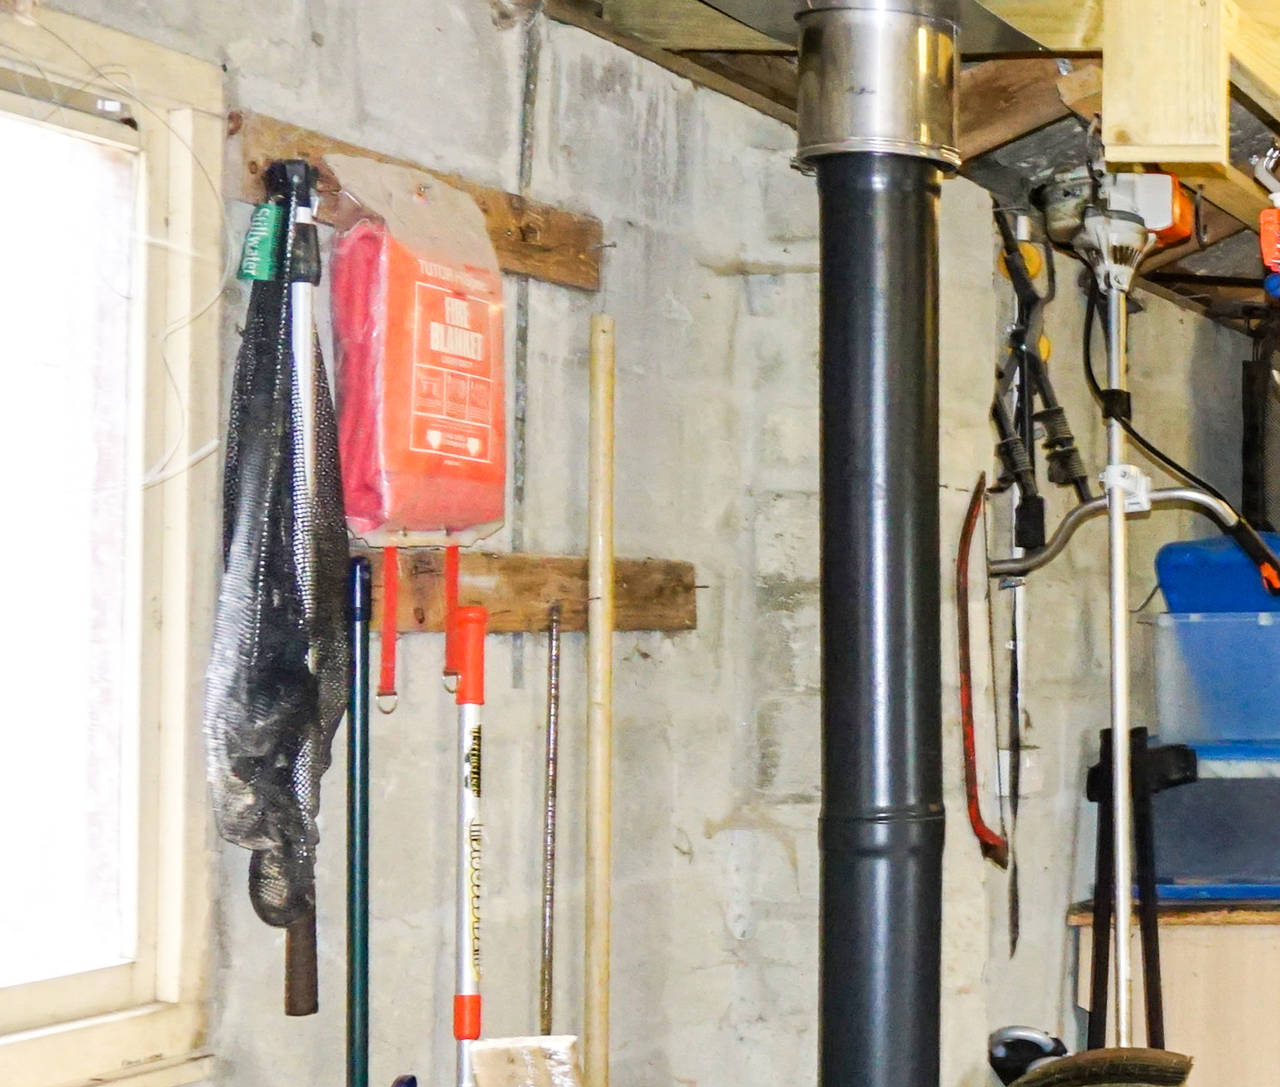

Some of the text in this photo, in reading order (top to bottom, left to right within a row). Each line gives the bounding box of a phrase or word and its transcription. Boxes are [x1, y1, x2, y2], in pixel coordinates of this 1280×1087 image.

[241, 207, 272, 277] Stillwater
[444, 296, 469, 329] FIRE
[430, 321, 483, 361] BLANKET
